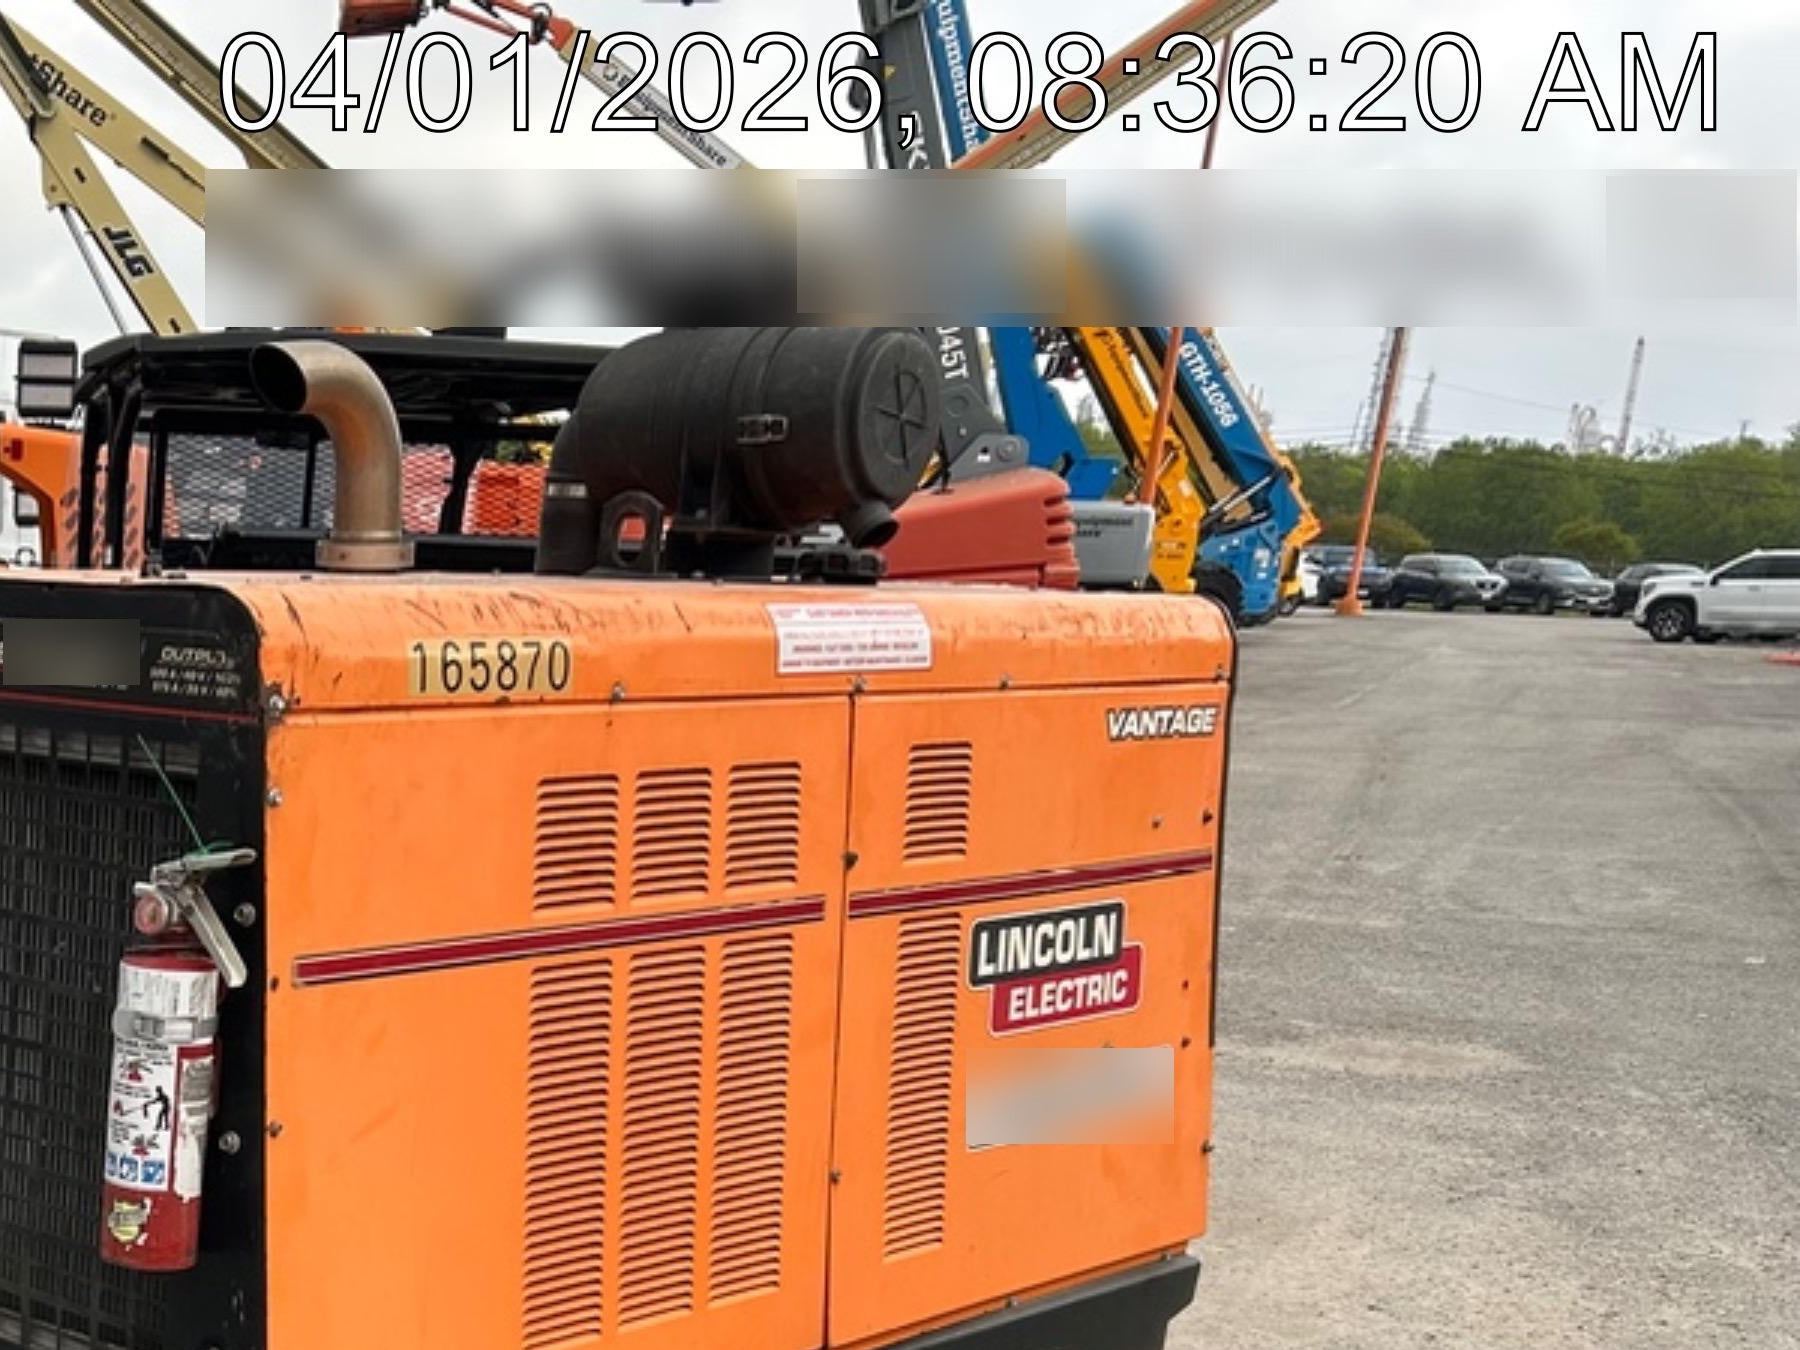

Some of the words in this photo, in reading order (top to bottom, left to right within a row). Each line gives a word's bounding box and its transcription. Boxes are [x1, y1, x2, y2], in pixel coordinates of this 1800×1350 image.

[102, 226, 154, 279] JLG
[413, 640, 571, 694] 165870
[1107, 705, 1219, 741] VANTAGE
[977, 911, 1118, 978] LINCOLN
[1007, 968, 1129, 1022] ELECTRIC
